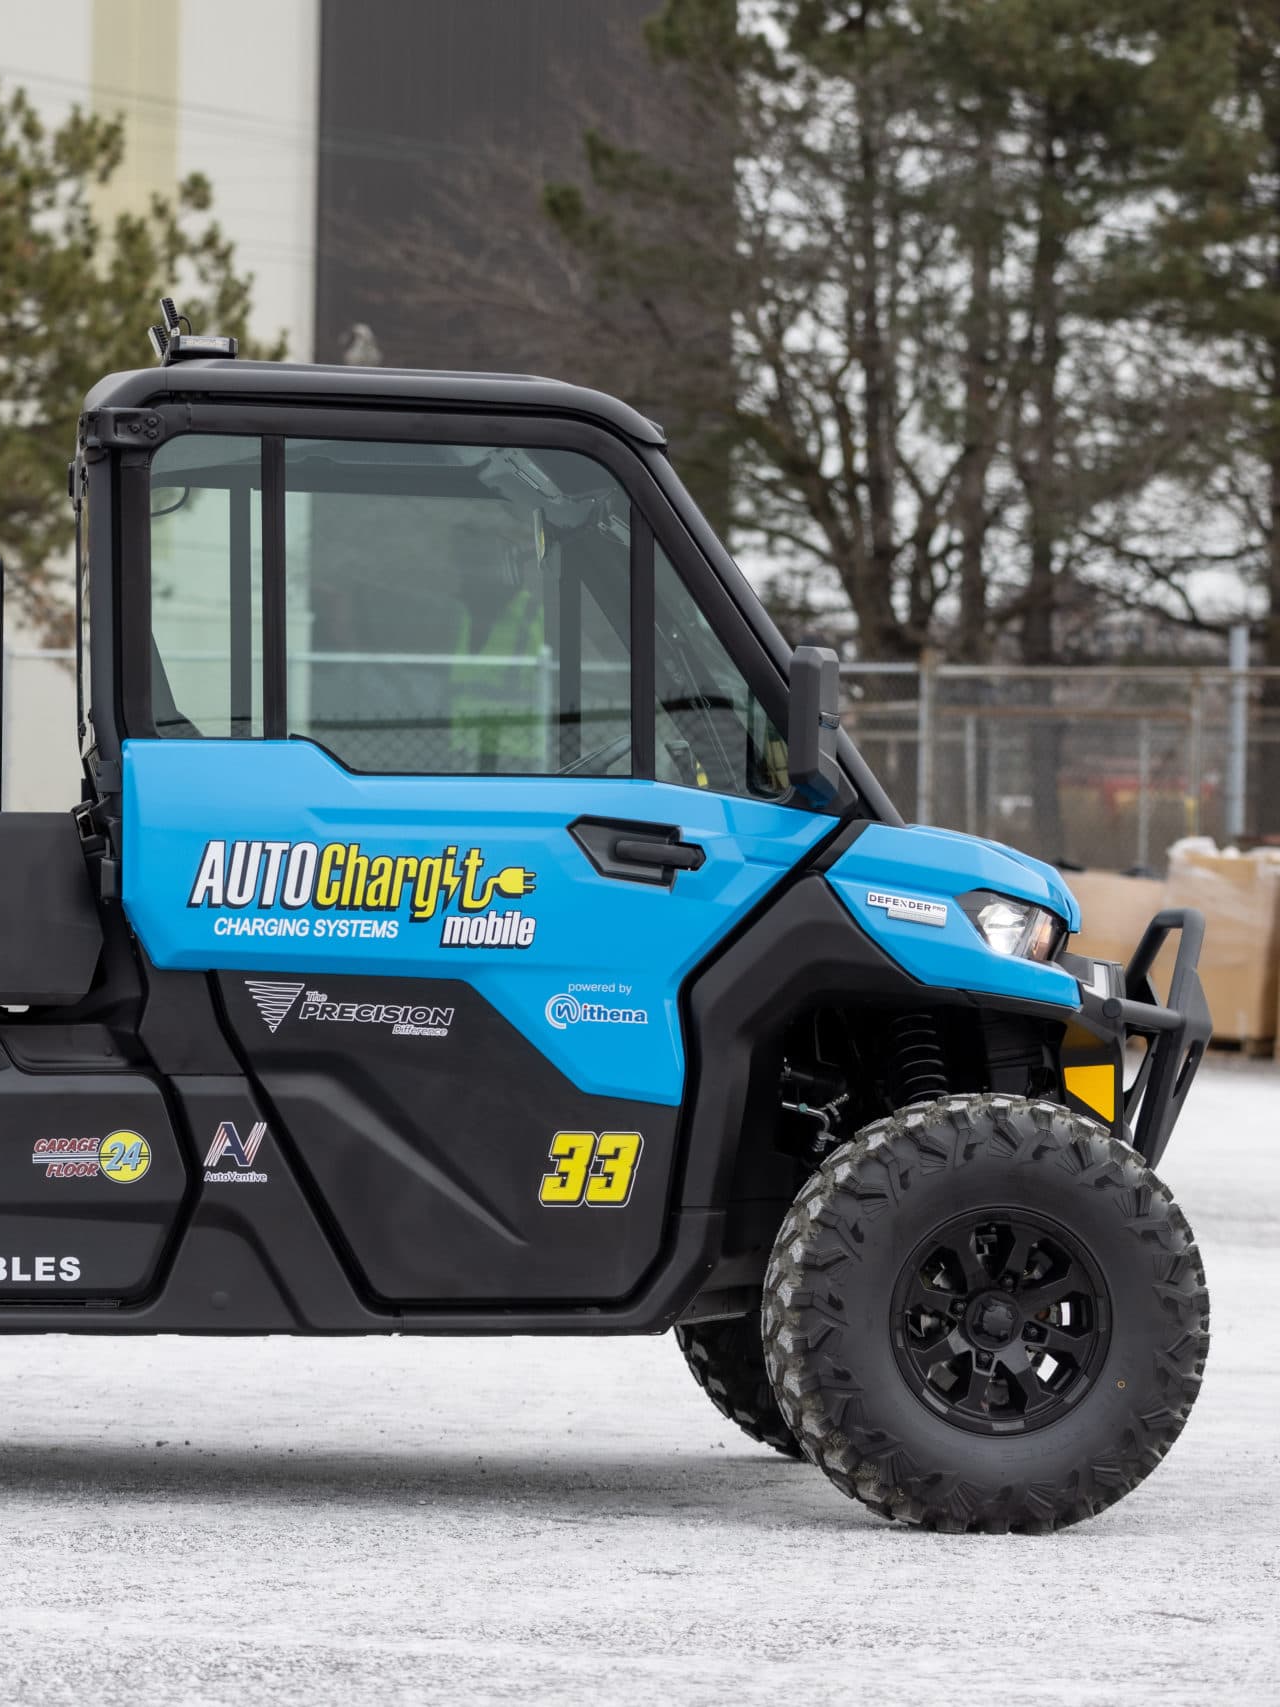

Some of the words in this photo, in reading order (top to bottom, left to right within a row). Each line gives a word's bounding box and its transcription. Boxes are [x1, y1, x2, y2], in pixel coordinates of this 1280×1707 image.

[869, 894, 932, 912] DEFENDER
[214, 917, 310, 937] CHARGING
[313, 919, 399, 939] SYSTEMS
[442, 910, 536, 947] mobile
[306, 991, 328, 1002] The
[568, 983, 616, 994] powered
[619, 983, 633, 996] by
[299, 1002, 455, 1026] PRECISION
[392, 1024, 448, 1037] Difference
[34, 1138, 100, 1153] GARAGE
[106, 1141, 143, 1172] 24
[46, 1163, 99, 1178] FLOOR
[204, 1171, 268, 1183] AutoVentive
[539, 1131, 644, 1207] 33
